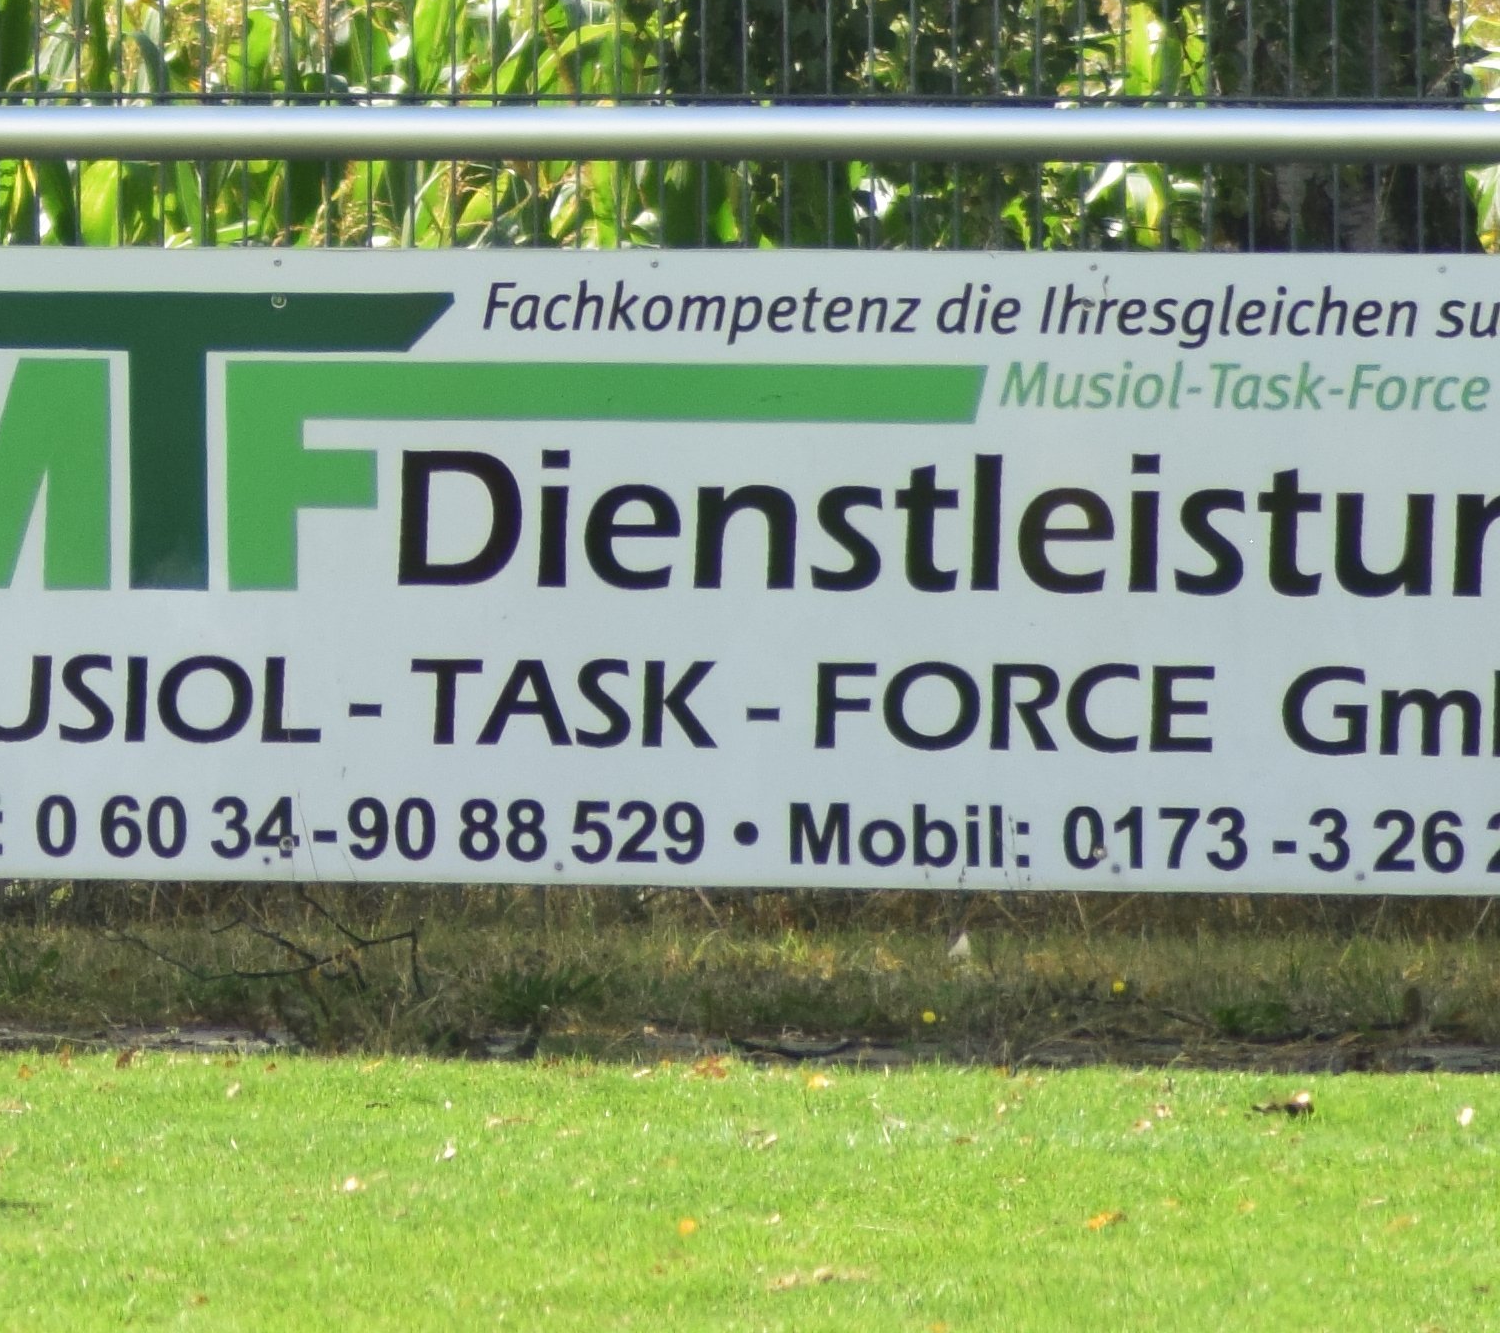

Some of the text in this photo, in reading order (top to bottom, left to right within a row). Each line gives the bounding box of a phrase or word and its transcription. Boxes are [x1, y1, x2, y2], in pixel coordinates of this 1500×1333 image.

[482, 279, 1500, 350] Fachkompetenz die Ihresgleichen su
[1000, 360, 1490, 413] Musiol-Task-Force
[410, 658, 718, 749] TASK
[814, 660, 1216, 754] FORCE
[1281, 665, 1500, 758] Gm
[458, 798, 548, 863] 88
[570, 800, 705, 865] 529
[789, 802, 1030, 869] Mobil:
